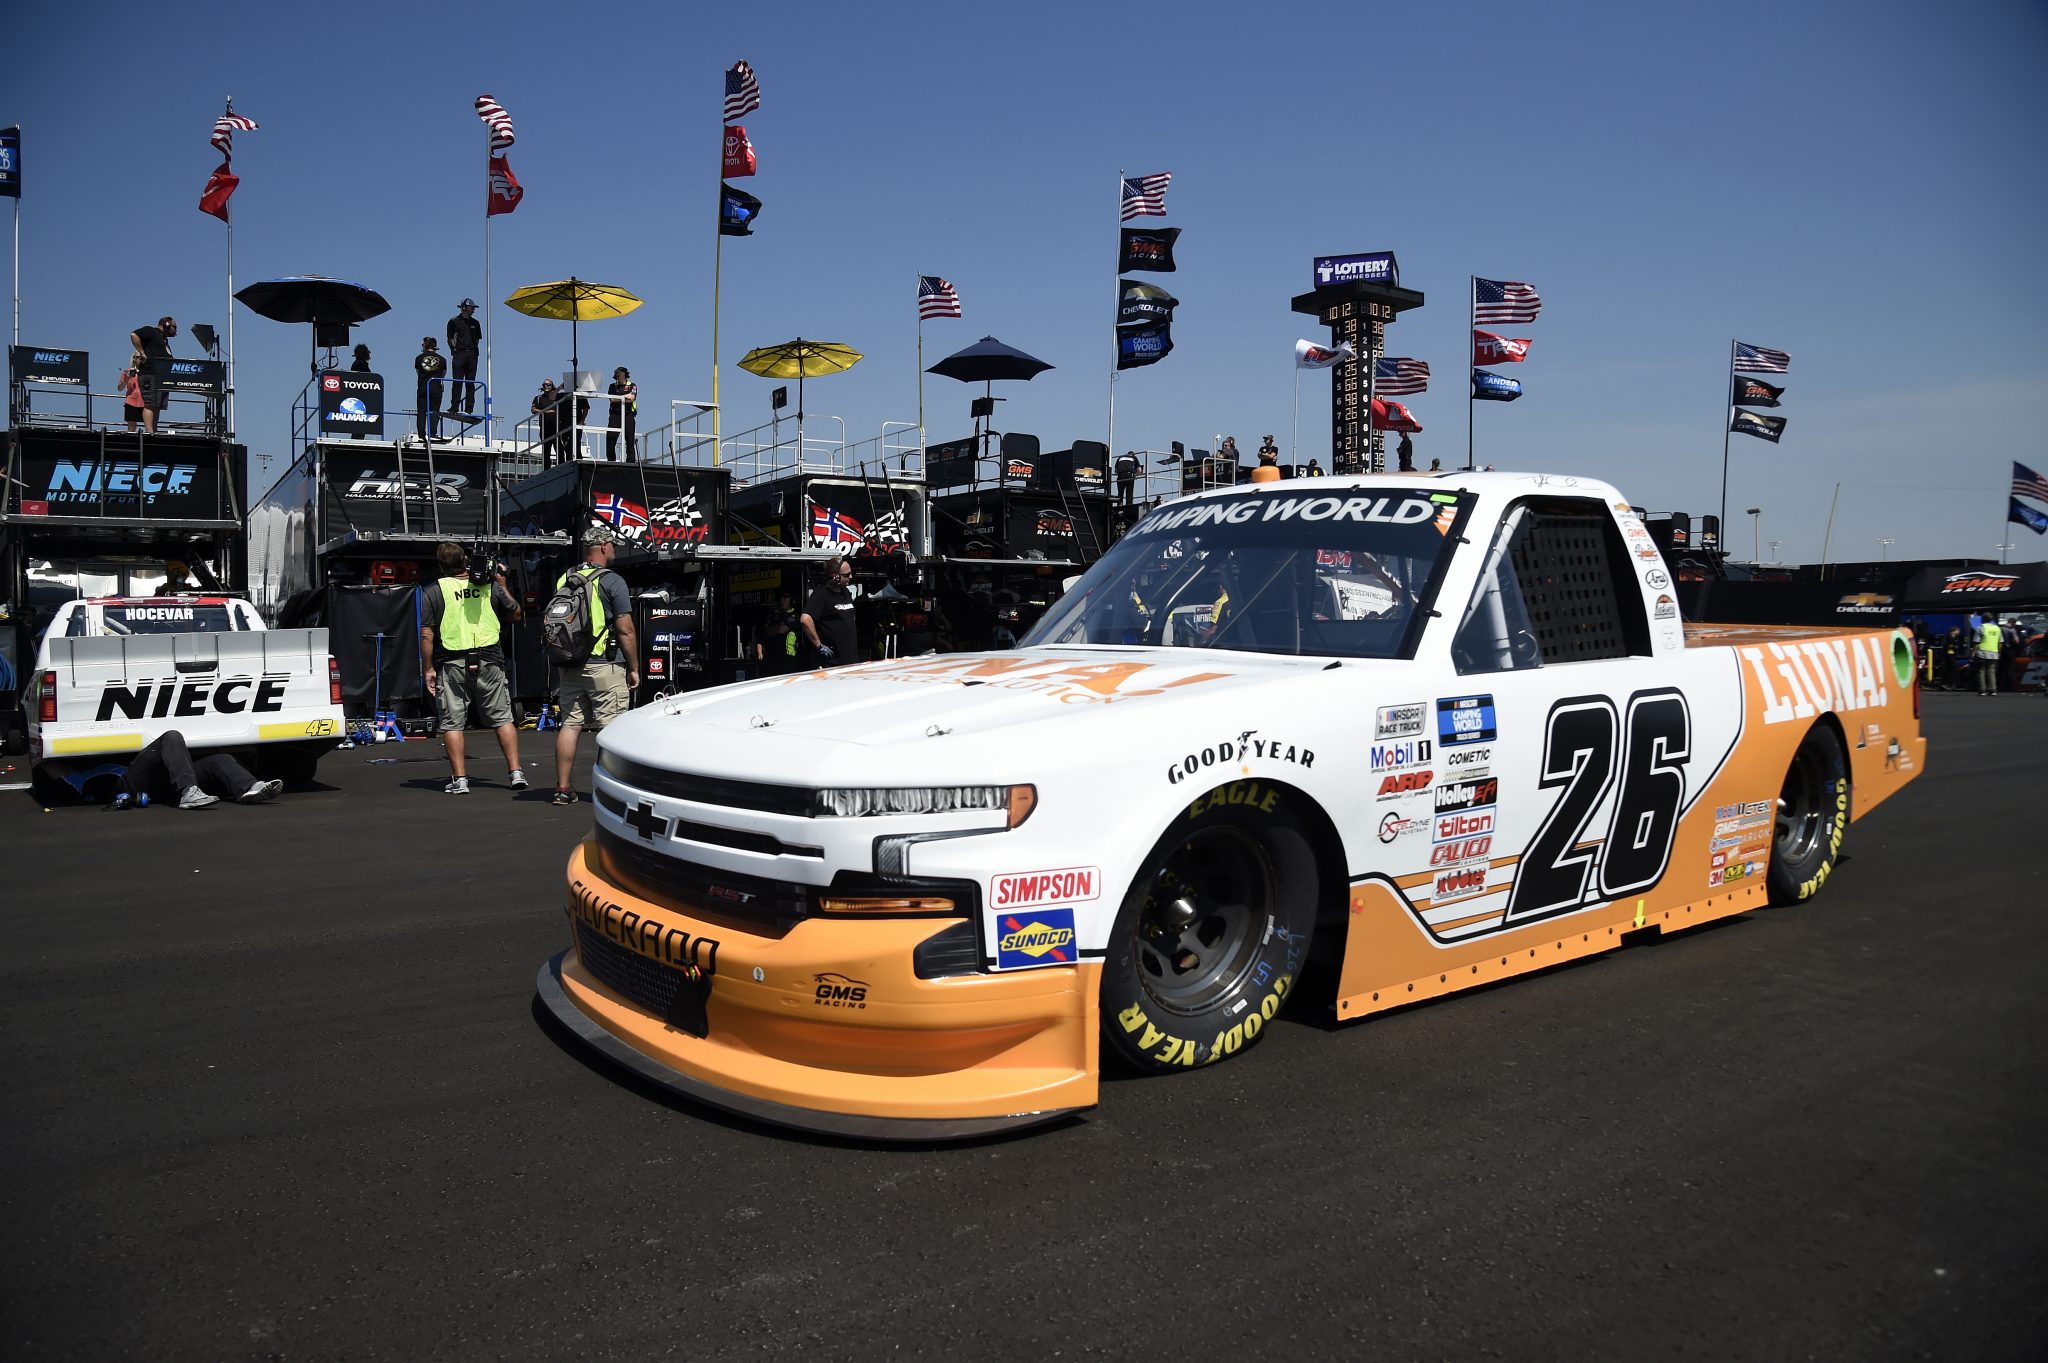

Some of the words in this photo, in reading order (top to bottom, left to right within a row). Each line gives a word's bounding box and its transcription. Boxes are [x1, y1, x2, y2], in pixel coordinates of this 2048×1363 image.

[1335, 260, 1389, 275] LOTTERY
[1336, 272, 1387, 280] TENNESSEE
[1122, 304, 1169, 315] CHEVROLET
[33, 352, 71, 362] NIECE
[1363, 351, 1368, 359] 3
[171, 363, 204, 373] NIECE
[343, 381, 381, 391] TOYOTA
[331, 413, 367, 422] HALMAR
[1363, 409, 1368, 417] 7
[1362, 453, 1369, 461] 10
[1008, 465, 1033, 473] GMS
[48, 459, 197, 494] NIECE
[1262, 498, 1435, 525] WORLD
[1941, 586, 2011, 594] RACING
[1945, 578, 2015, 590] GMS
[454, 588, 480, 601] NBC
[125, 608, 194, 621] HOCEVAR
[95, 672, 291, 721] NIECE
[1391, 708, 1420, 721] NASCAR
[1452, 709, 1482, 721] CAMPING
[305, 719, 334, 737] 42
[1379, 725, 1397, 734] RACE
[1400, 722, 1420, 732] TRUCK
[1453, 718, 1483, 732] WORLD
[1371, 742, 1413, 768] Mobil
[1419, 741, 1430, 761] 1
[1449, 748, 1491, 766] COMETIC
[1377, 770, 1433, 796] ARP
[1190, 781, 1280, 820] EAGLE
[1436, 784, 1476, 807] Holley
[1505, 686, 1691, 923] 26
[1439, 815, 1492, 838] tilton
[1430, 835, 1492, 866] CALICO
[1710, 871, 1723, 886] 3M
[997, 872, 1091, 904] SIMPSON
[571, 880, 720, 975] SILVERADO
[1003, 929, 1070, 951] SUNOCO
[816, 984, 867, 1002] GMS
[815, 999, 866, 1009] RACING
